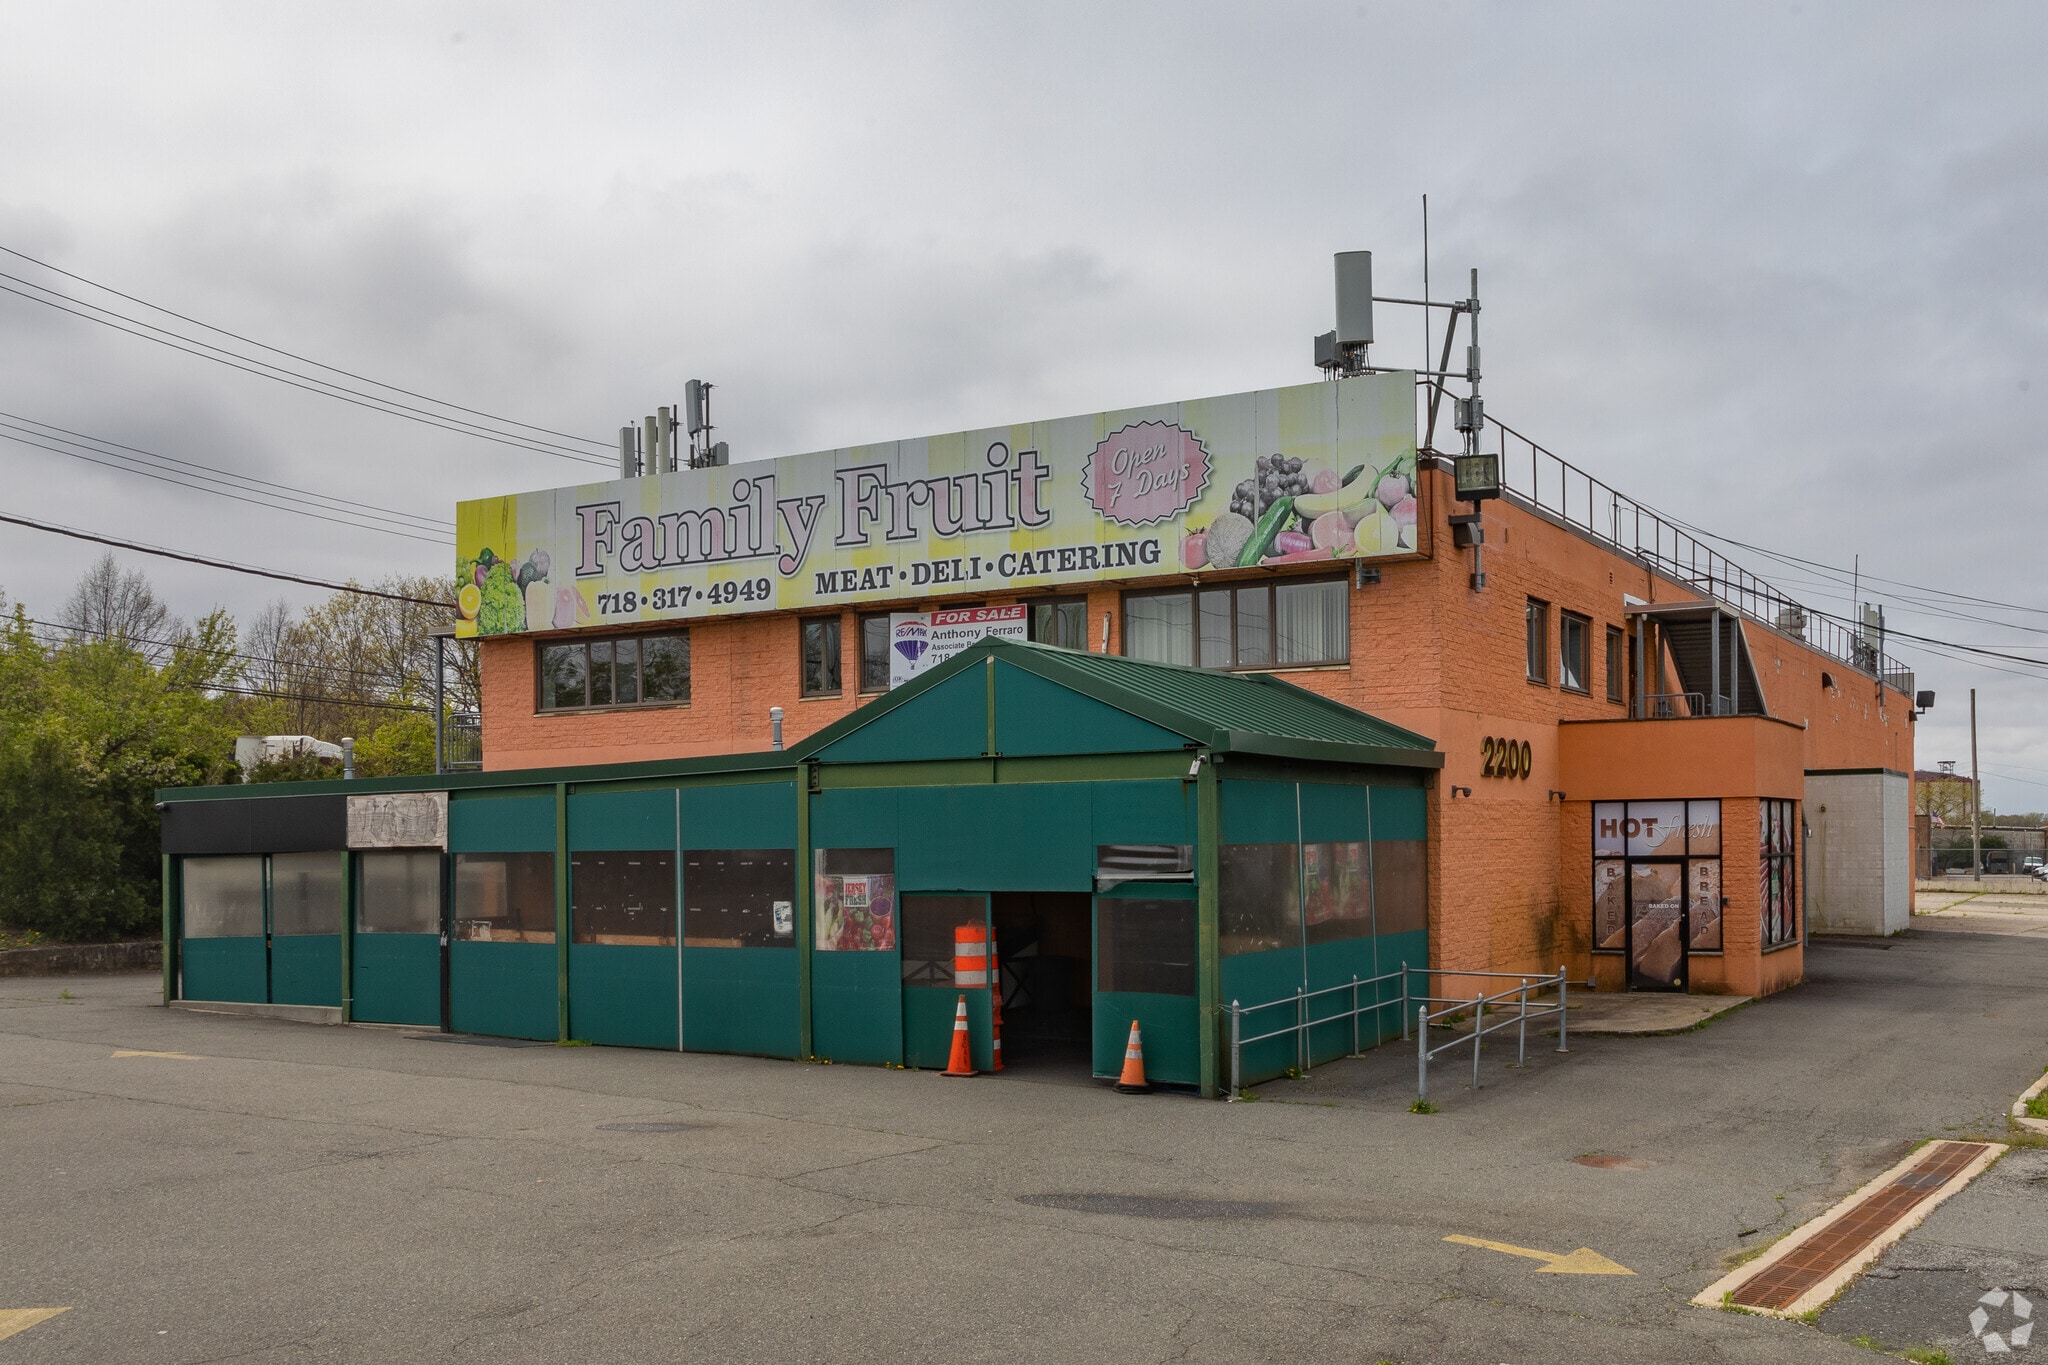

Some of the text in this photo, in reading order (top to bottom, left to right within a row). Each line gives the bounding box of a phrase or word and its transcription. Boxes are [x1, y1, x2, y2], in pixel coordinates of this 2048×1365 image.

[1111, 443, 1167, 479] Open
[1108, 463, 1190, 508] 7 Days
[575, 442, 1050, 575] Family Fruit
[935, 607, 1021, 624] FOR SALE
[931, 625, 1024, 641] Anthony Ferraro
[932, 641, 965, 651] Associate
[1480, 735, 1532, 779] 2200
[1600, 817, 1658, 839] HOT
[845, 882, 867, 895] JERSEY
[845, 894, 867, 905] FRESH
